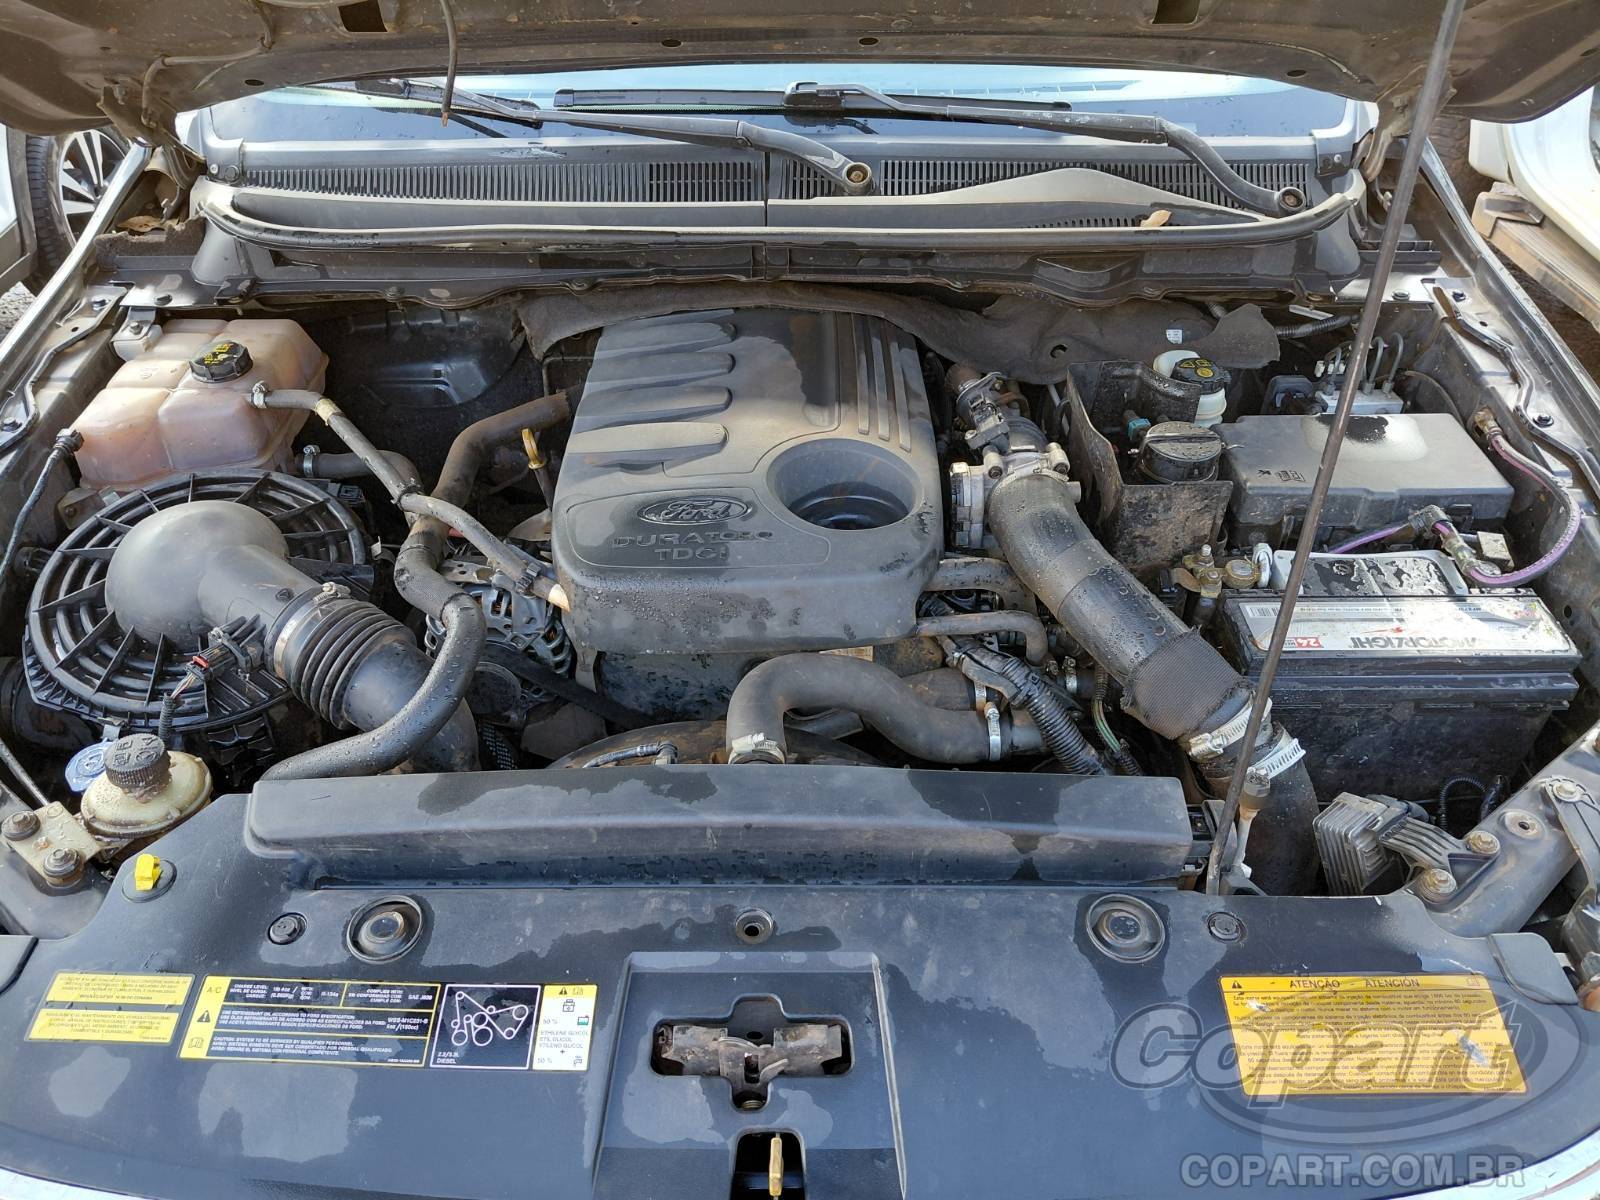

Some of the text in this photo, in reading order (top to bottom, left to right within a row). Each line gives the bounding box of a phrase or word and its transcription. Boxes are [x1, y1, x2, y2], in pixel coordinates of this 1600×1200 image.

[661, 499, 731, 521] Ford
[1296, 637, 1320, 648] 24
[1365, 976, 1420, 988] ATENCIÓN
